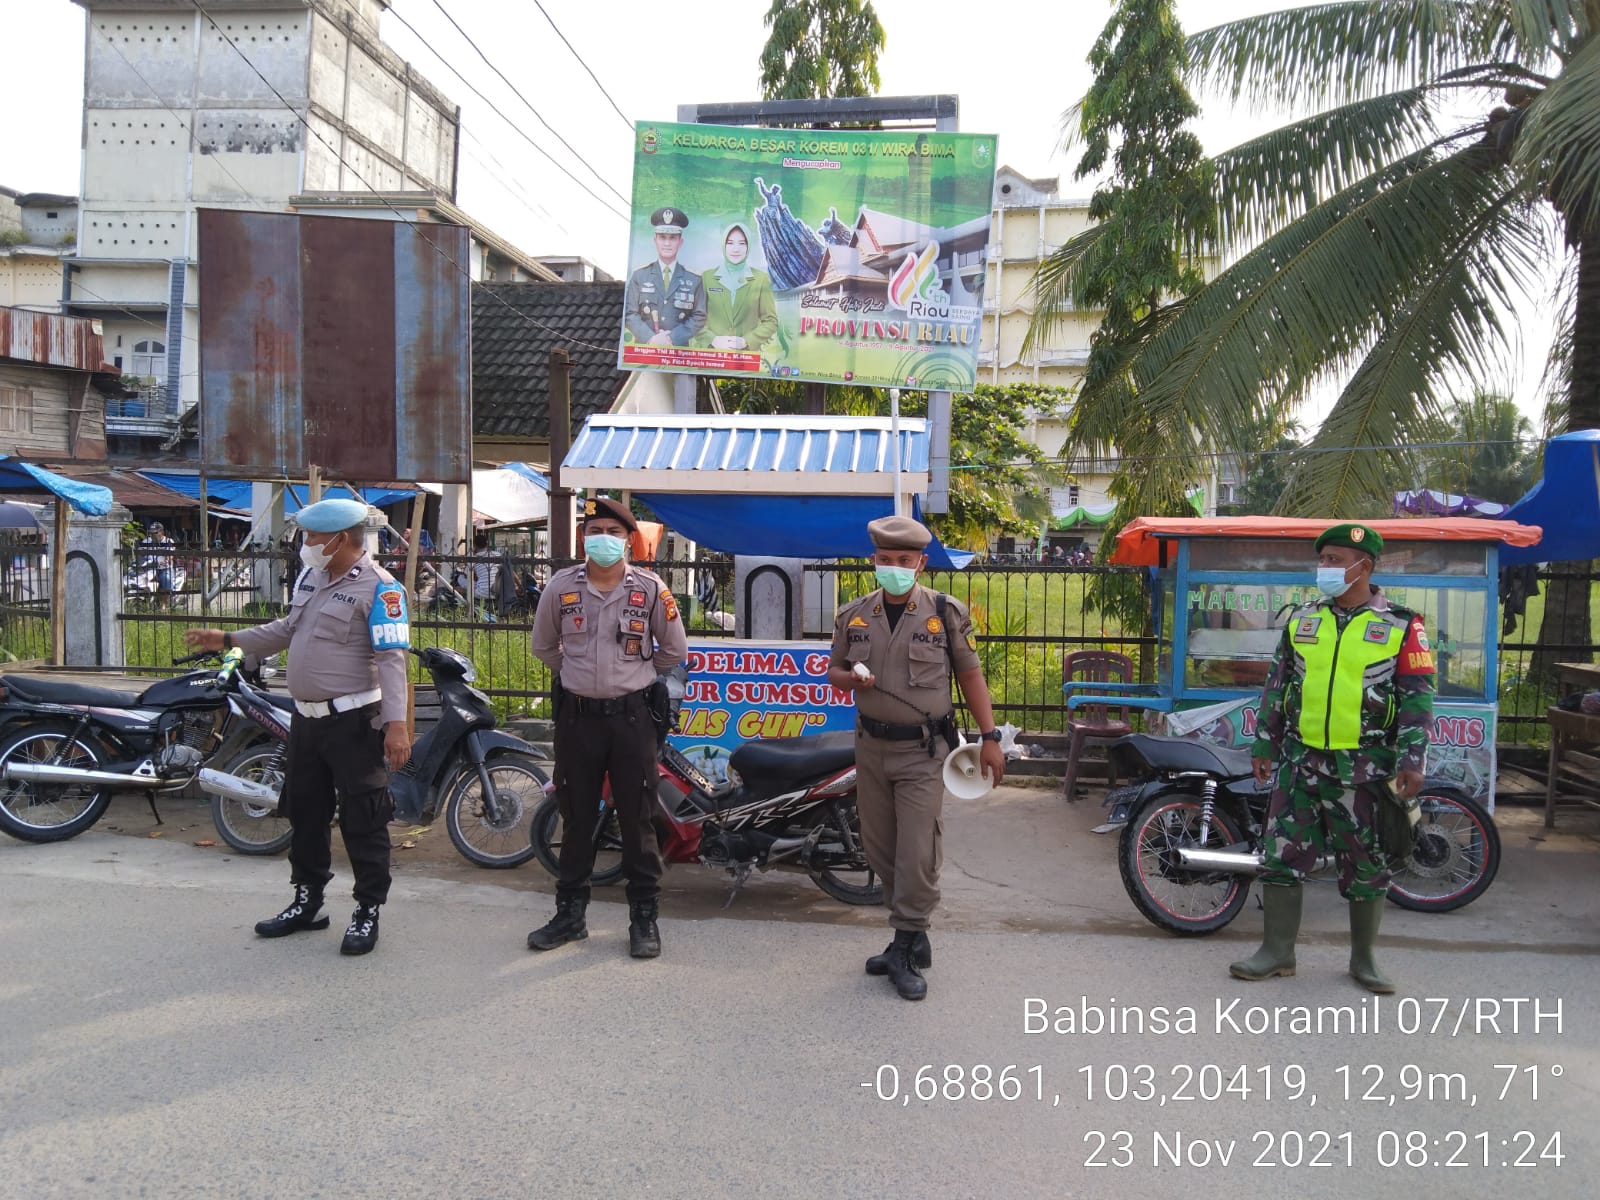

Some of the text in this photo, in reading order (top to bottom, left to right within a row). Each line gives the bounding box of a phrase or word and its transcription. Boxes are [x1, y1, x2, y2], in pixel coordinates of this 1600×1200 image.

[672, 133, 747, 150] KELUARGA
[749, 138, 797, 153] BESAR
[799, 140, 849, 156] KOREM
[881, 142, 918, 157] WIRA
[920, 143, 956, 159] BIMA
[783, 158, 841, 169] Mengucapkan
[910, 301, 949, 318] Riau
[800, 317, 976, 344] PROVINSI RIAU
[332, 592, 357, 605] POLRI
[623, 608, 649, 619] POLRI
[912, 633, 931, 642] POL
[688, 652, 829, 675] DELIMA &
[684, 681, 855, 706] UR SUMSUM
